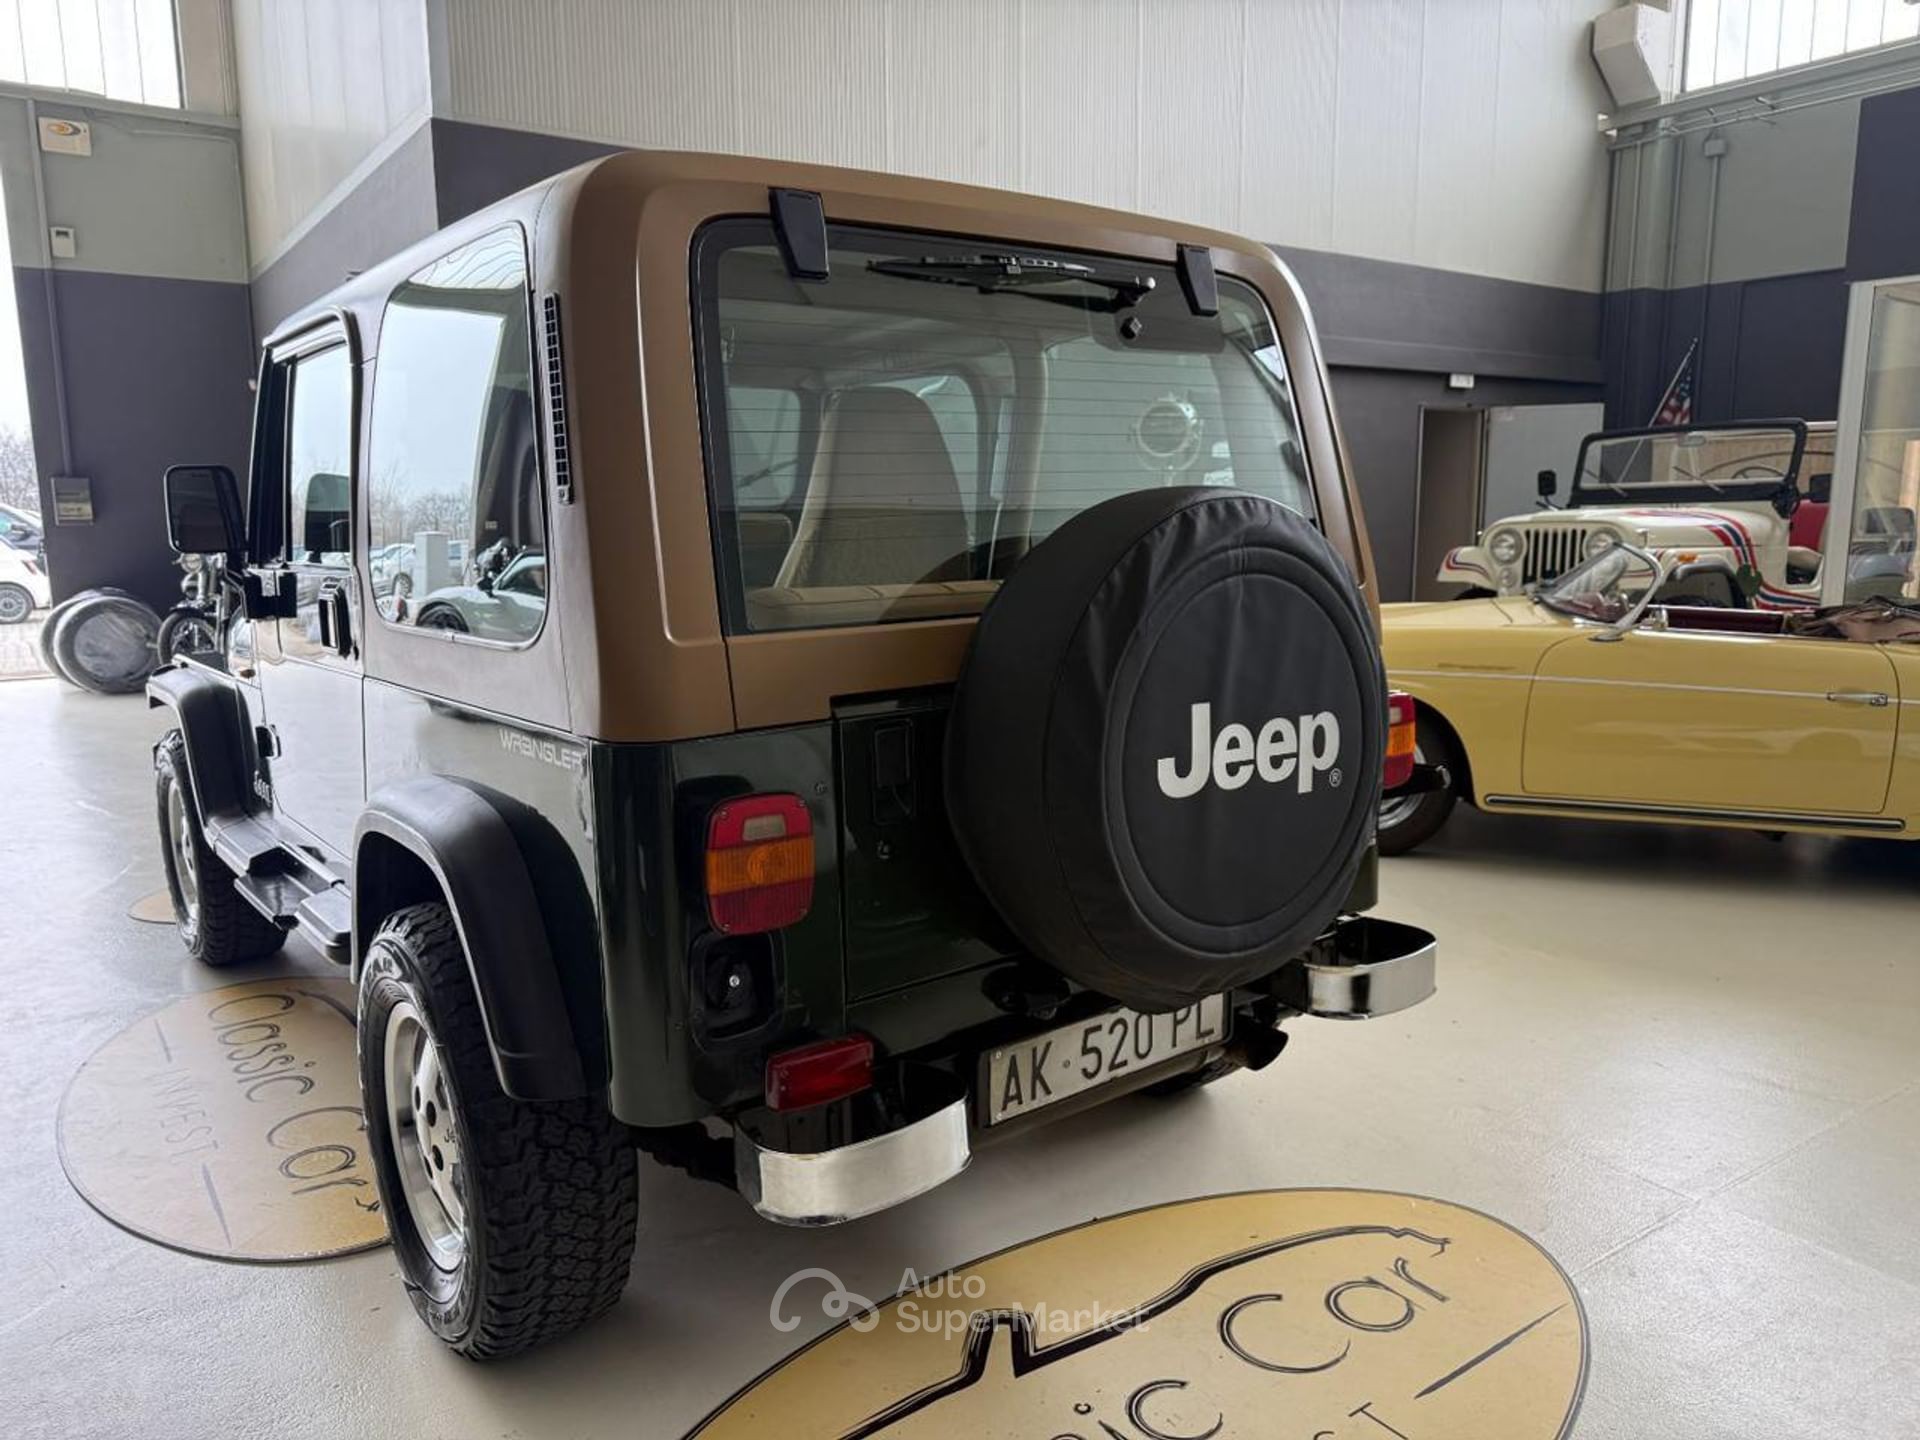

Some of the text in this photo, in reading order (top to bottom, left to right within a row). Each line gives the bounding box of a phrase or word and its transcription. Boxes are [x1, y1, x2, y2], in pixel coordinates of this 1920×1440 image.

[498, 728, 586, 773] WRANGLER
[1157, 702, 1341, 799] Jeep
[208, 993, 370, 1194] Classic Car
[1001, 1000, 1215, 1112] AK 520 PL
[1217, 1256, 1449, 1374] Car
